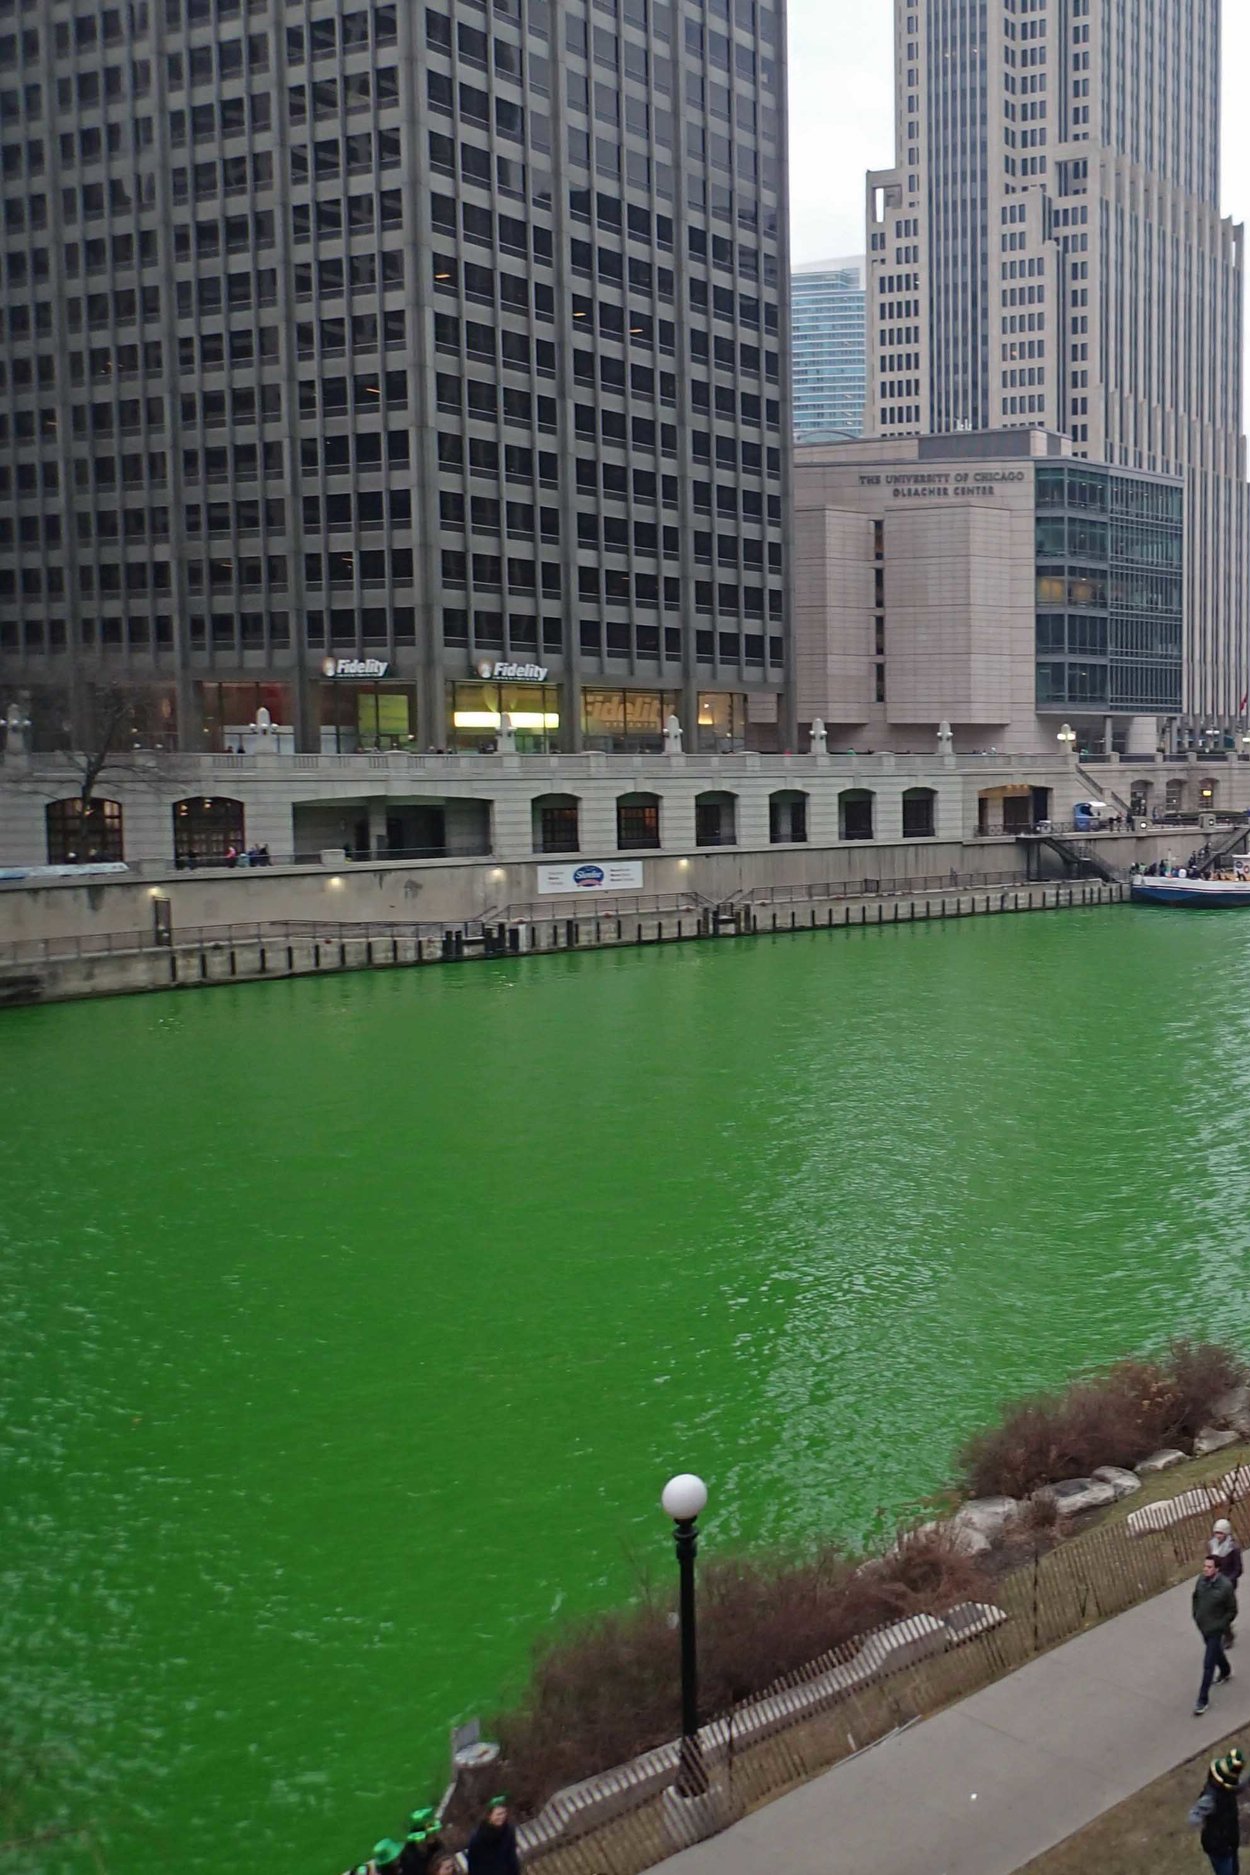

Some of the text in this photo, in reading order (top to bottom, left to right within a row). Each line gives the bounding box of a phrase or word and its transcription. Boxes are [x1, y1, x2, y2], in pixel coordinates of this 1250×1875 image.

[859, 471, 1025, 485] THE UNIVERSITY OF CHICAGO
[953, 485, 995, 497] CENTER
[336, 658, 389, 677] Fidelity
[493, 662, 548, 682] Fidelity
